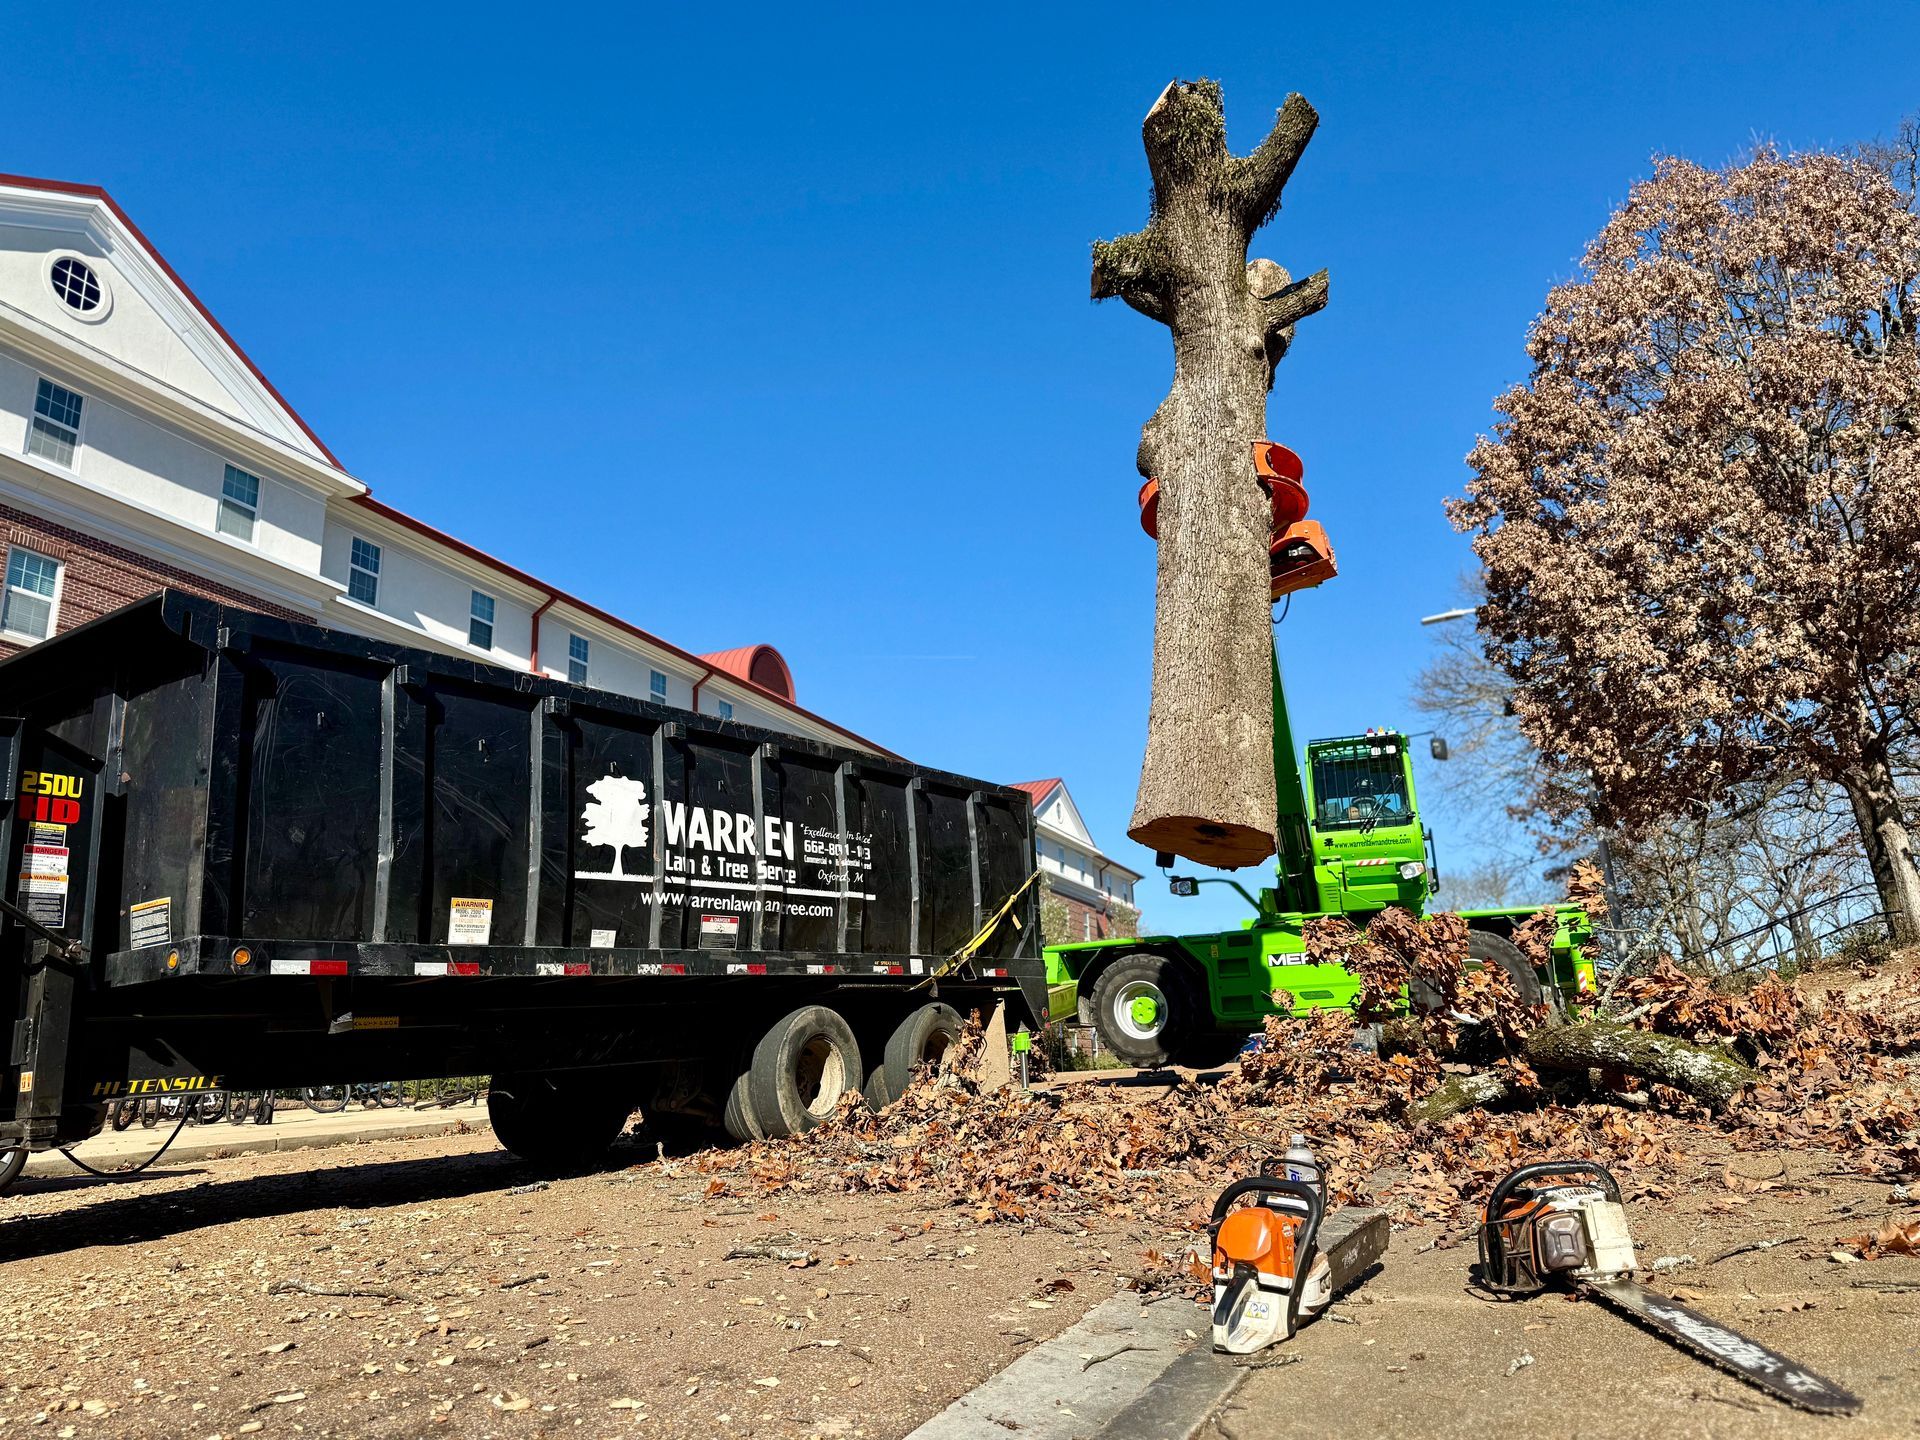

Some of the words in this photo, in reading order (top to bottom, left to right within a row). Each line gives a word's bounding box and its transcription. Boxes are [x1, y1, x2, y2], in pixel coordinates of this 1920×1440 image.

[22, 771, 83, 798] 25DU
[662, 799, 794, 861] WARREN
[701, 854, 712, 876] &
[717, 856, 749, 879] Tree
[92, 1074, 225, 1097] HI-TENSILE
